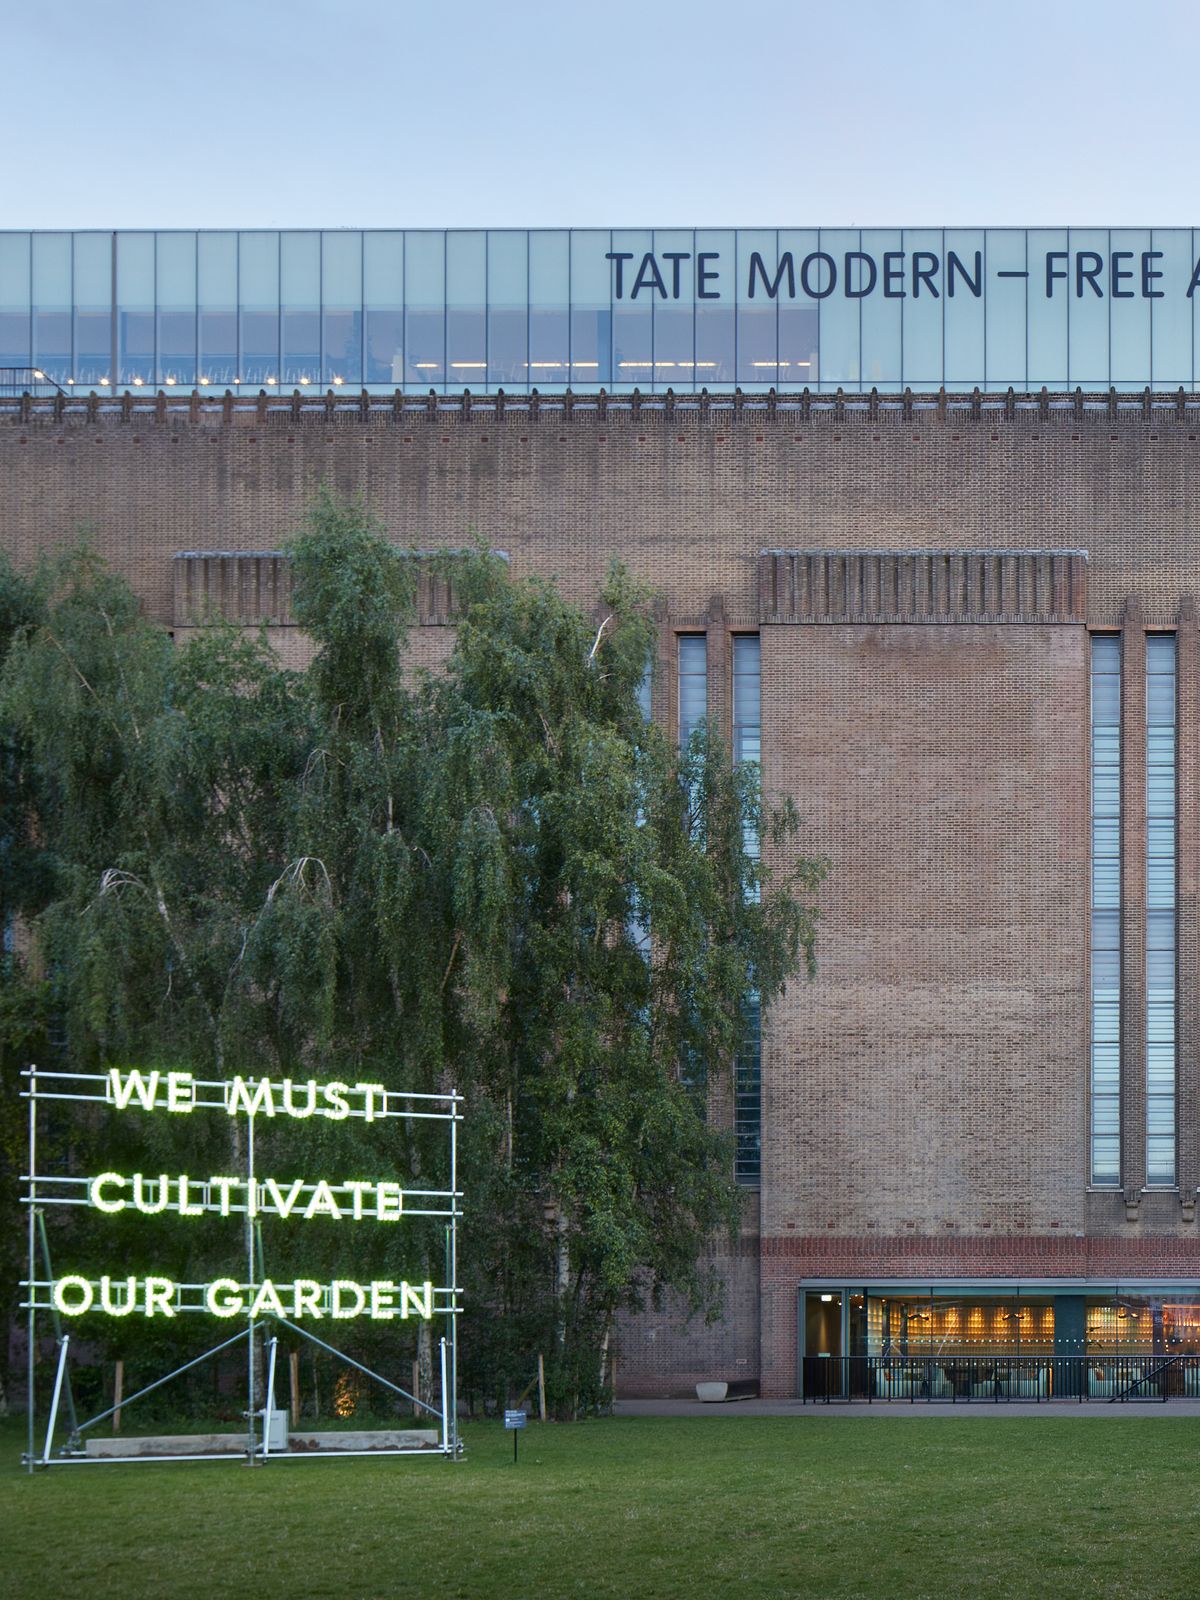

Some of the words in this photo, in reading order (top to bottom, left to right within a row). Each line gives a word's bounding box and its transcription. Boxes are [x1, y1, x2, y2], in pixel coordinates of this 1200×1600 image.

[605, 253, 720, 299] TATE
[748, 251, 982, 299] MODERN
[1045, 252, 1165, 298] FREE
[109, 1068, 195, 1113] WE
[227, 1075, 384, 1122] MUST
[90, 1172, 401, 1221] CULTIVATE
[53, 1275, 176, 1318] OUR
[206, 1278, 433, 1319] GARDEN
